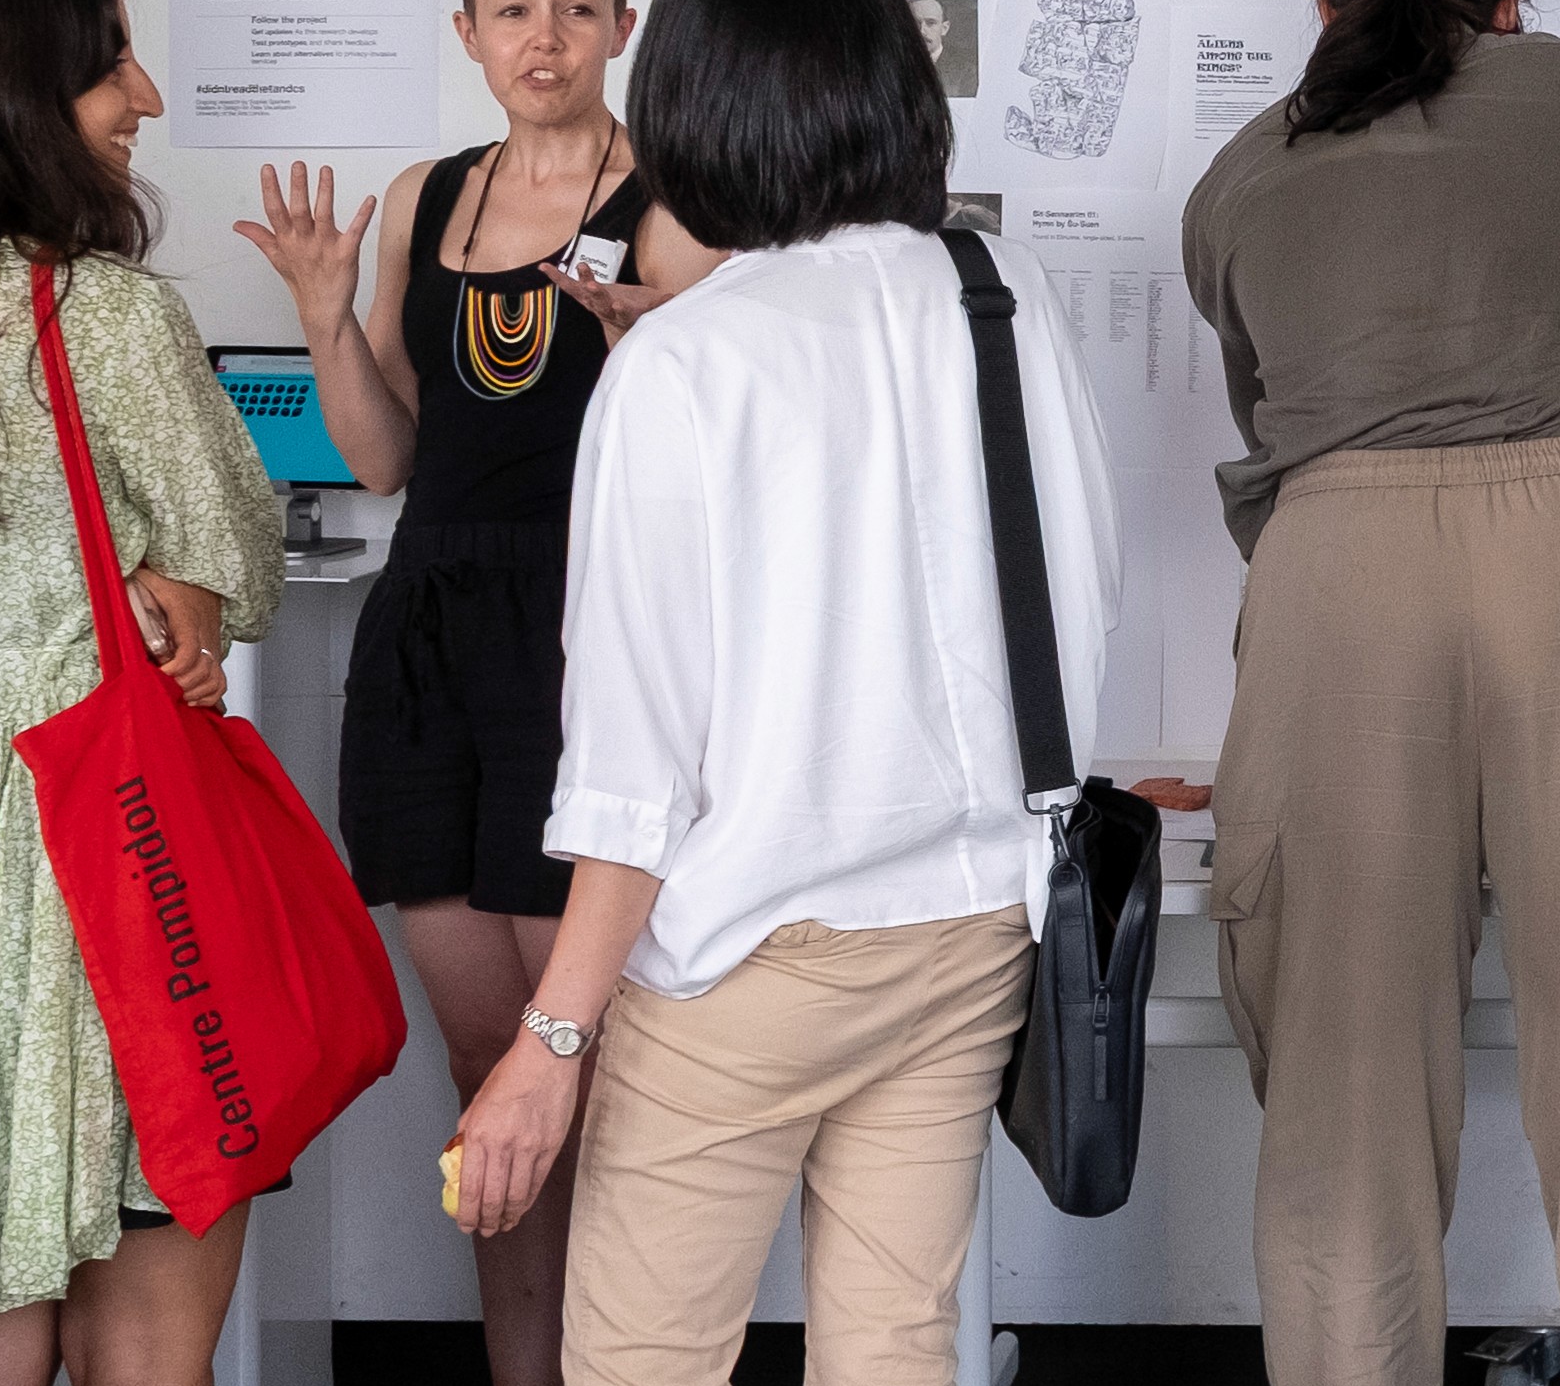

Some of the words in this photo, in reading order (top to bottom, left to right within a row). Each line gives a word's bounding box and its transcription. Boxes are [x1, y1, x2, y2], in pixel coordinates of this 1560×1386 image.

[251, 16, 279, 24] Follow
[281, 16, 295, 24] the
[297, 16, 327, 25] project
[1056, 220, 1065, 229] by
[115, 774, 211, 1004] Pompidou
[189, 1007, 259, 1160] Centre
